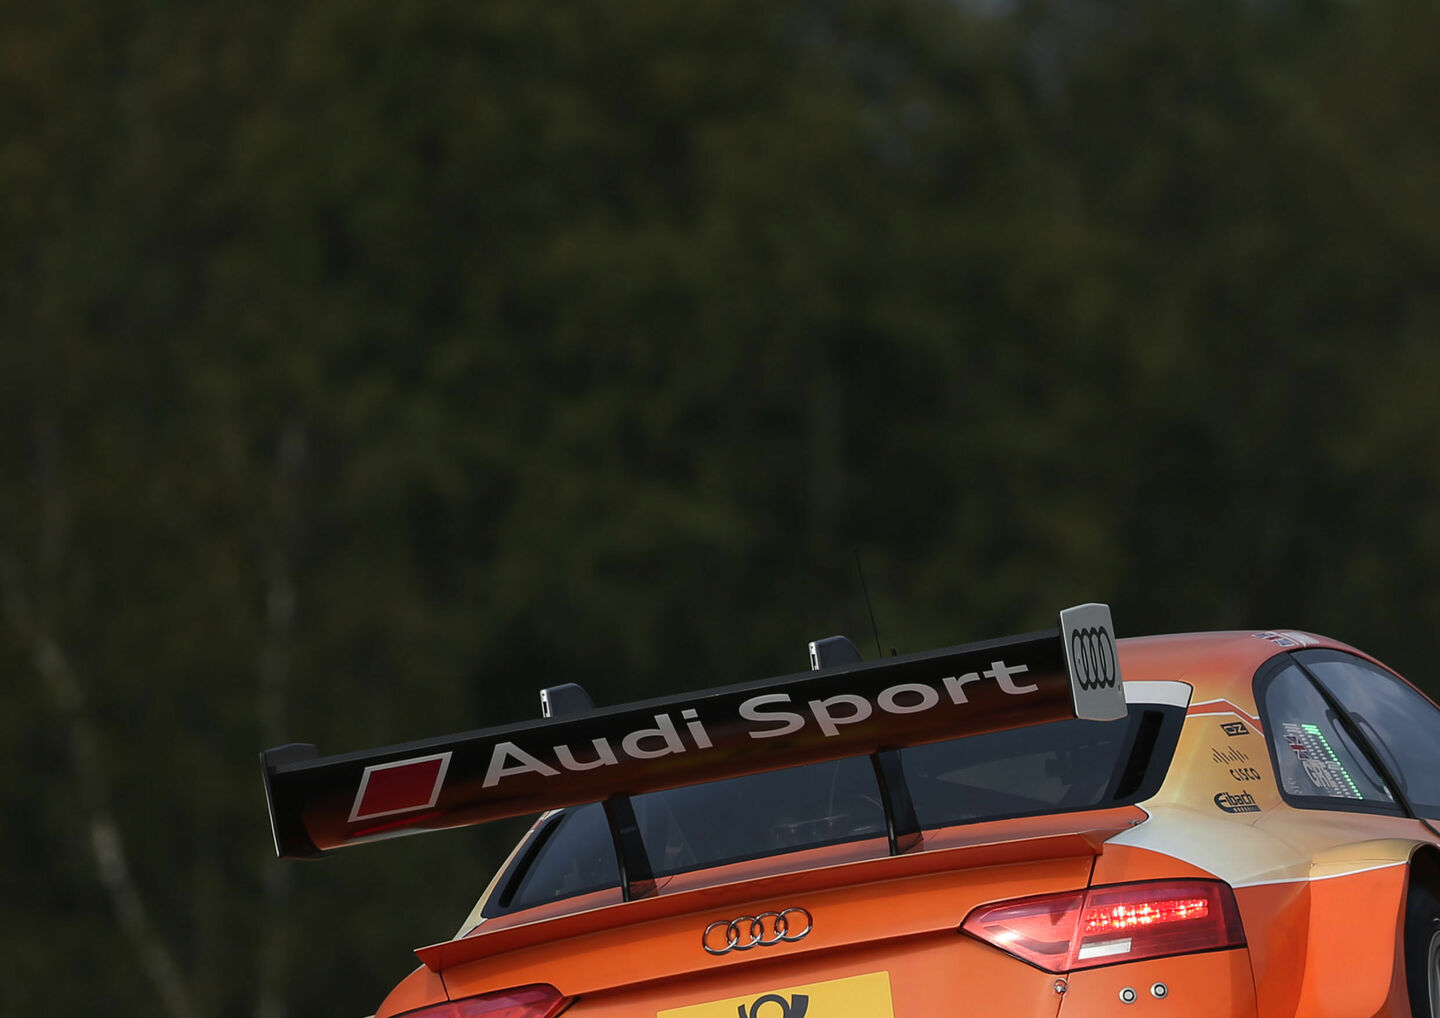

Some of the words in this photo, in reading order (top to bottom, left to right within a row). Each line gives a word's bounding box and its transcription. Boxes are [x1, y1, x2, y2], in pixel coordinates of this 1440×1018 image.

[482, 708, 714, 788] Audi
[737, 659, 1040, 738] Sport
[1213, 789, 1261, 814] Eibach
